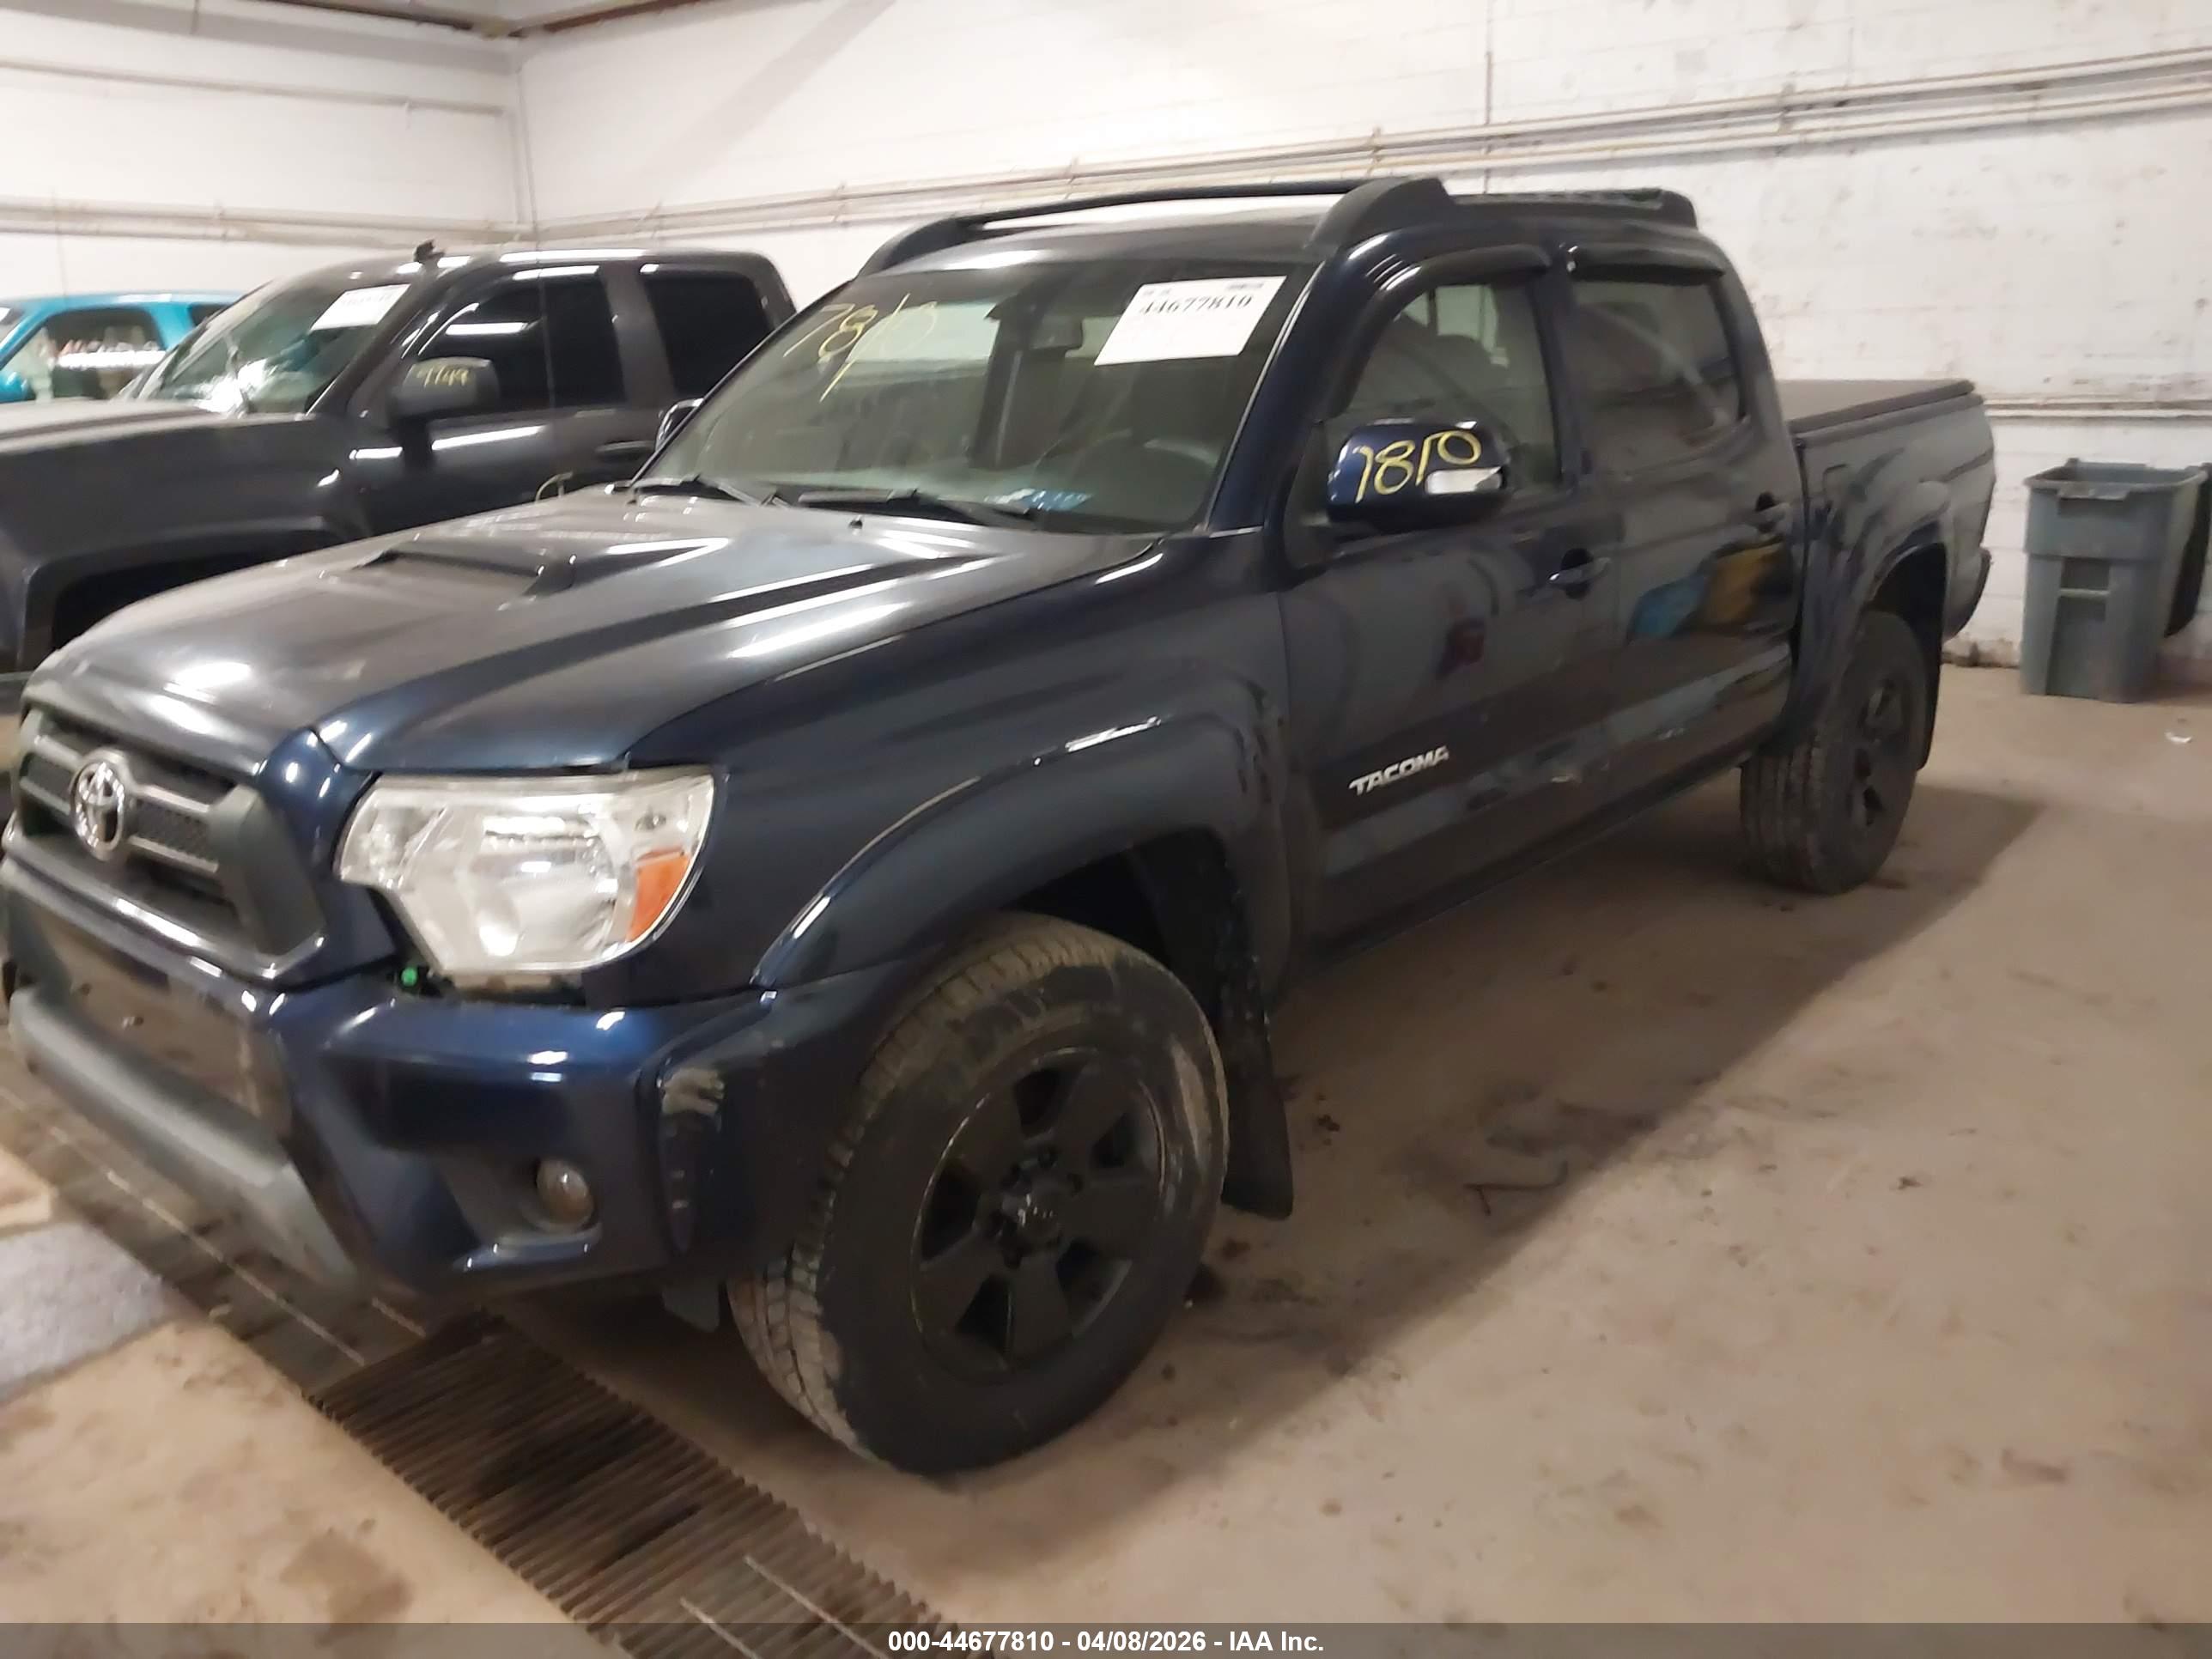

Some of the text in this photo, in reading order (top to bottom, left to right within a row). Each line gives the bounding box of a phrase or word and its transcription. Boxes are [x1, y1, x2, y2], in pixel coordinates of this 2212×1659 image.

[1140, 294, 1253, 315] 44677810
[782, 293, 937, 402] 7810
[1352, 430, 1482, 504] 7810
[1348, 745, 1449, 795] TACOMA
